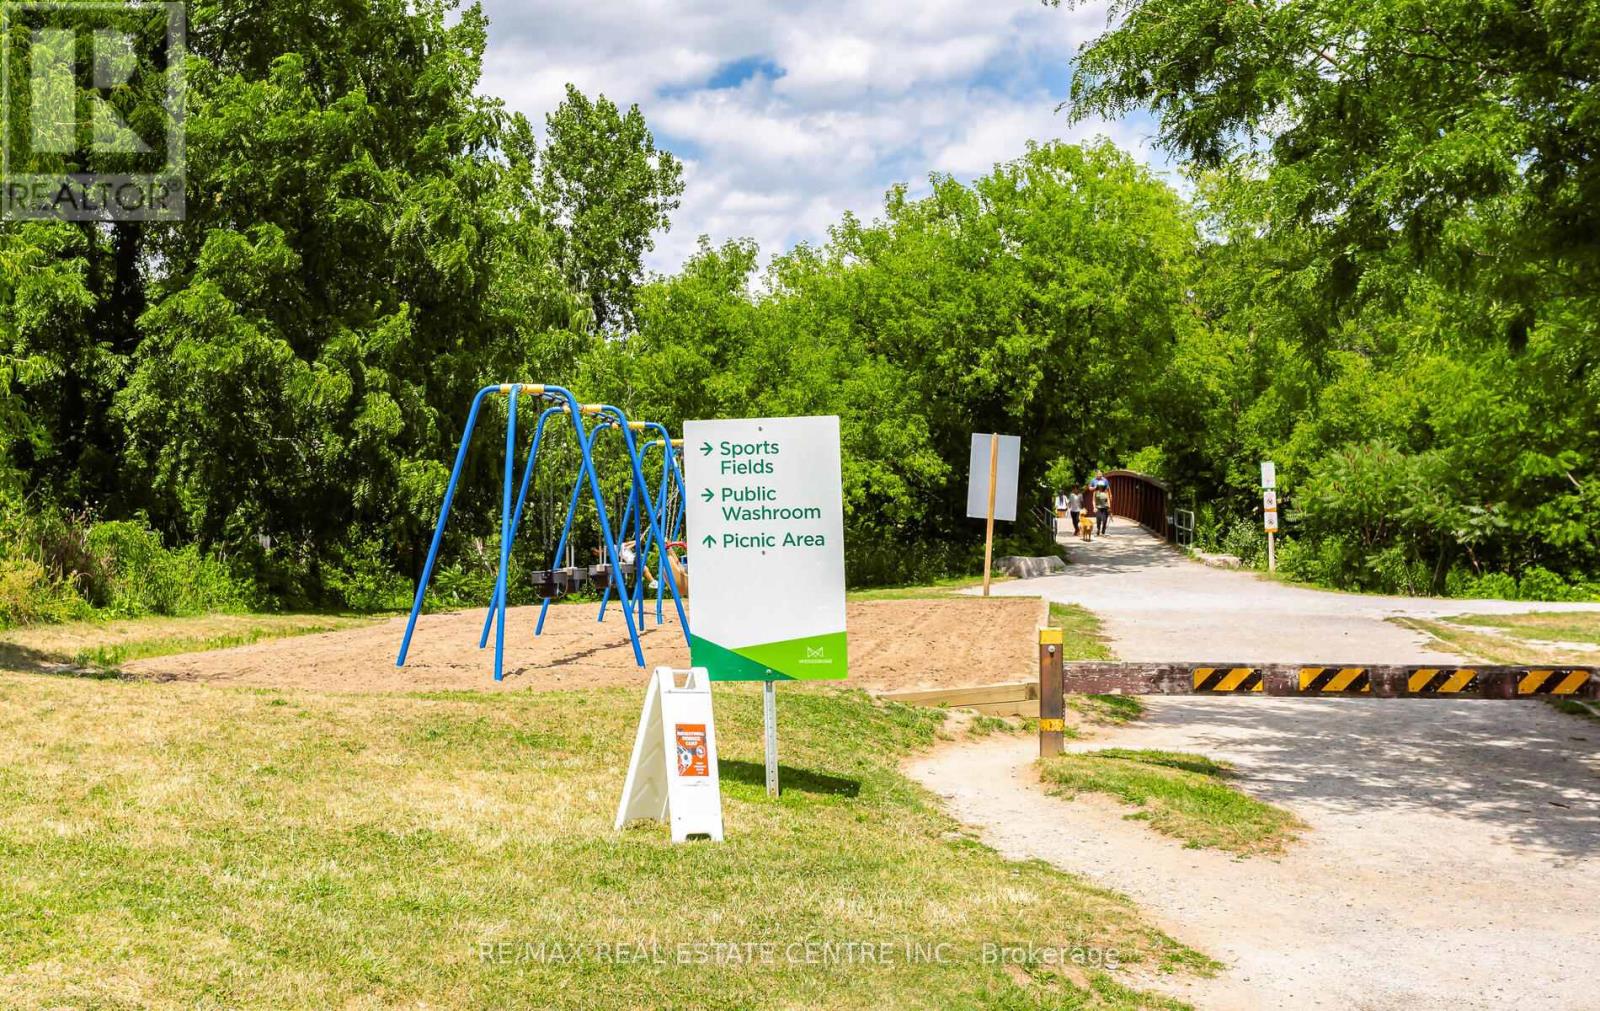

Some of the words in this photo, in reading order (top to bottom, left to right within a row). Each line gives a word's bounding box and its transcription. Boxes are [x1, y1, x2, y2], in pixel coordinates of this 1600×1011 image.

[720, 441, 779, 458] Sports
[721, 459, 774, 475] Fields
[722, 486, 777, 502] Public
[722, 505, 821, 521] Washroom
[723, 533, 775, 548] Picnic
[782, 532, 825, 547] Area
